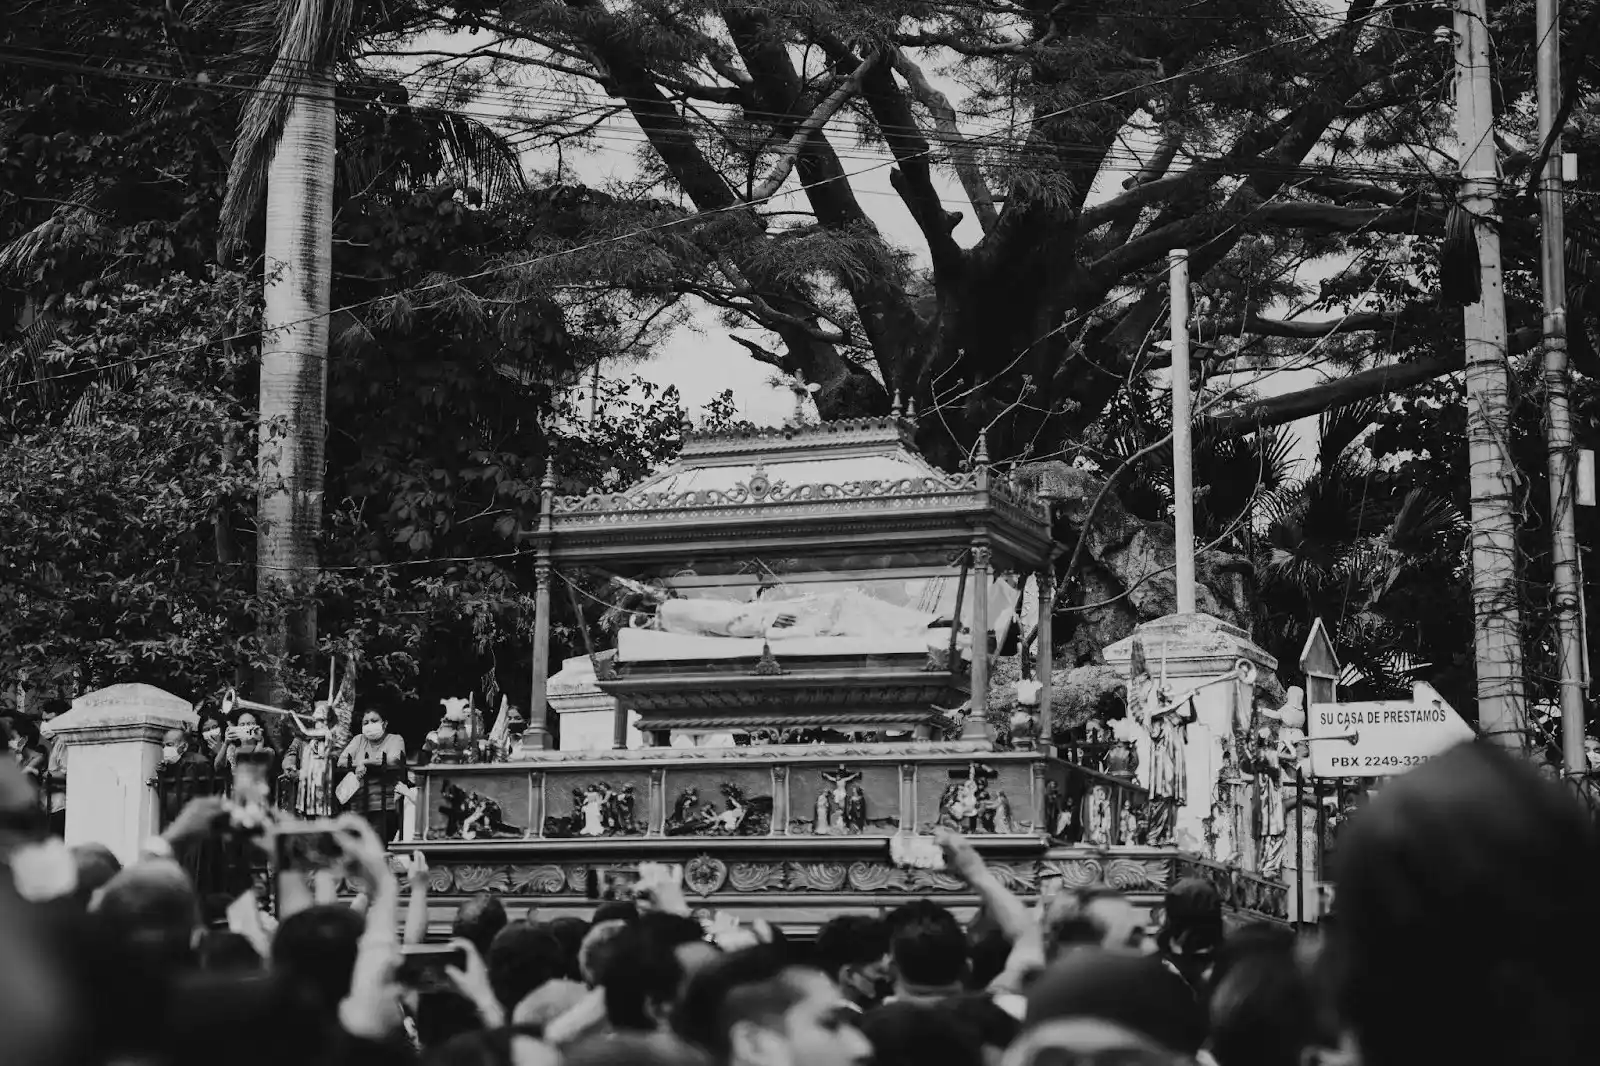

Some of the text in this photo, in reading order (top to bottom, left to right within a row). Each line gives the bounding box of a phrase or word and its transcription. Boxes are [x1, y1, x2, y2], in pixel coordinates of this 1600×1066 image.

[1320, 709, 1446, 725] SU CASA DE PRESTAMOS
[1331, 757, 1359, 767] PBX
